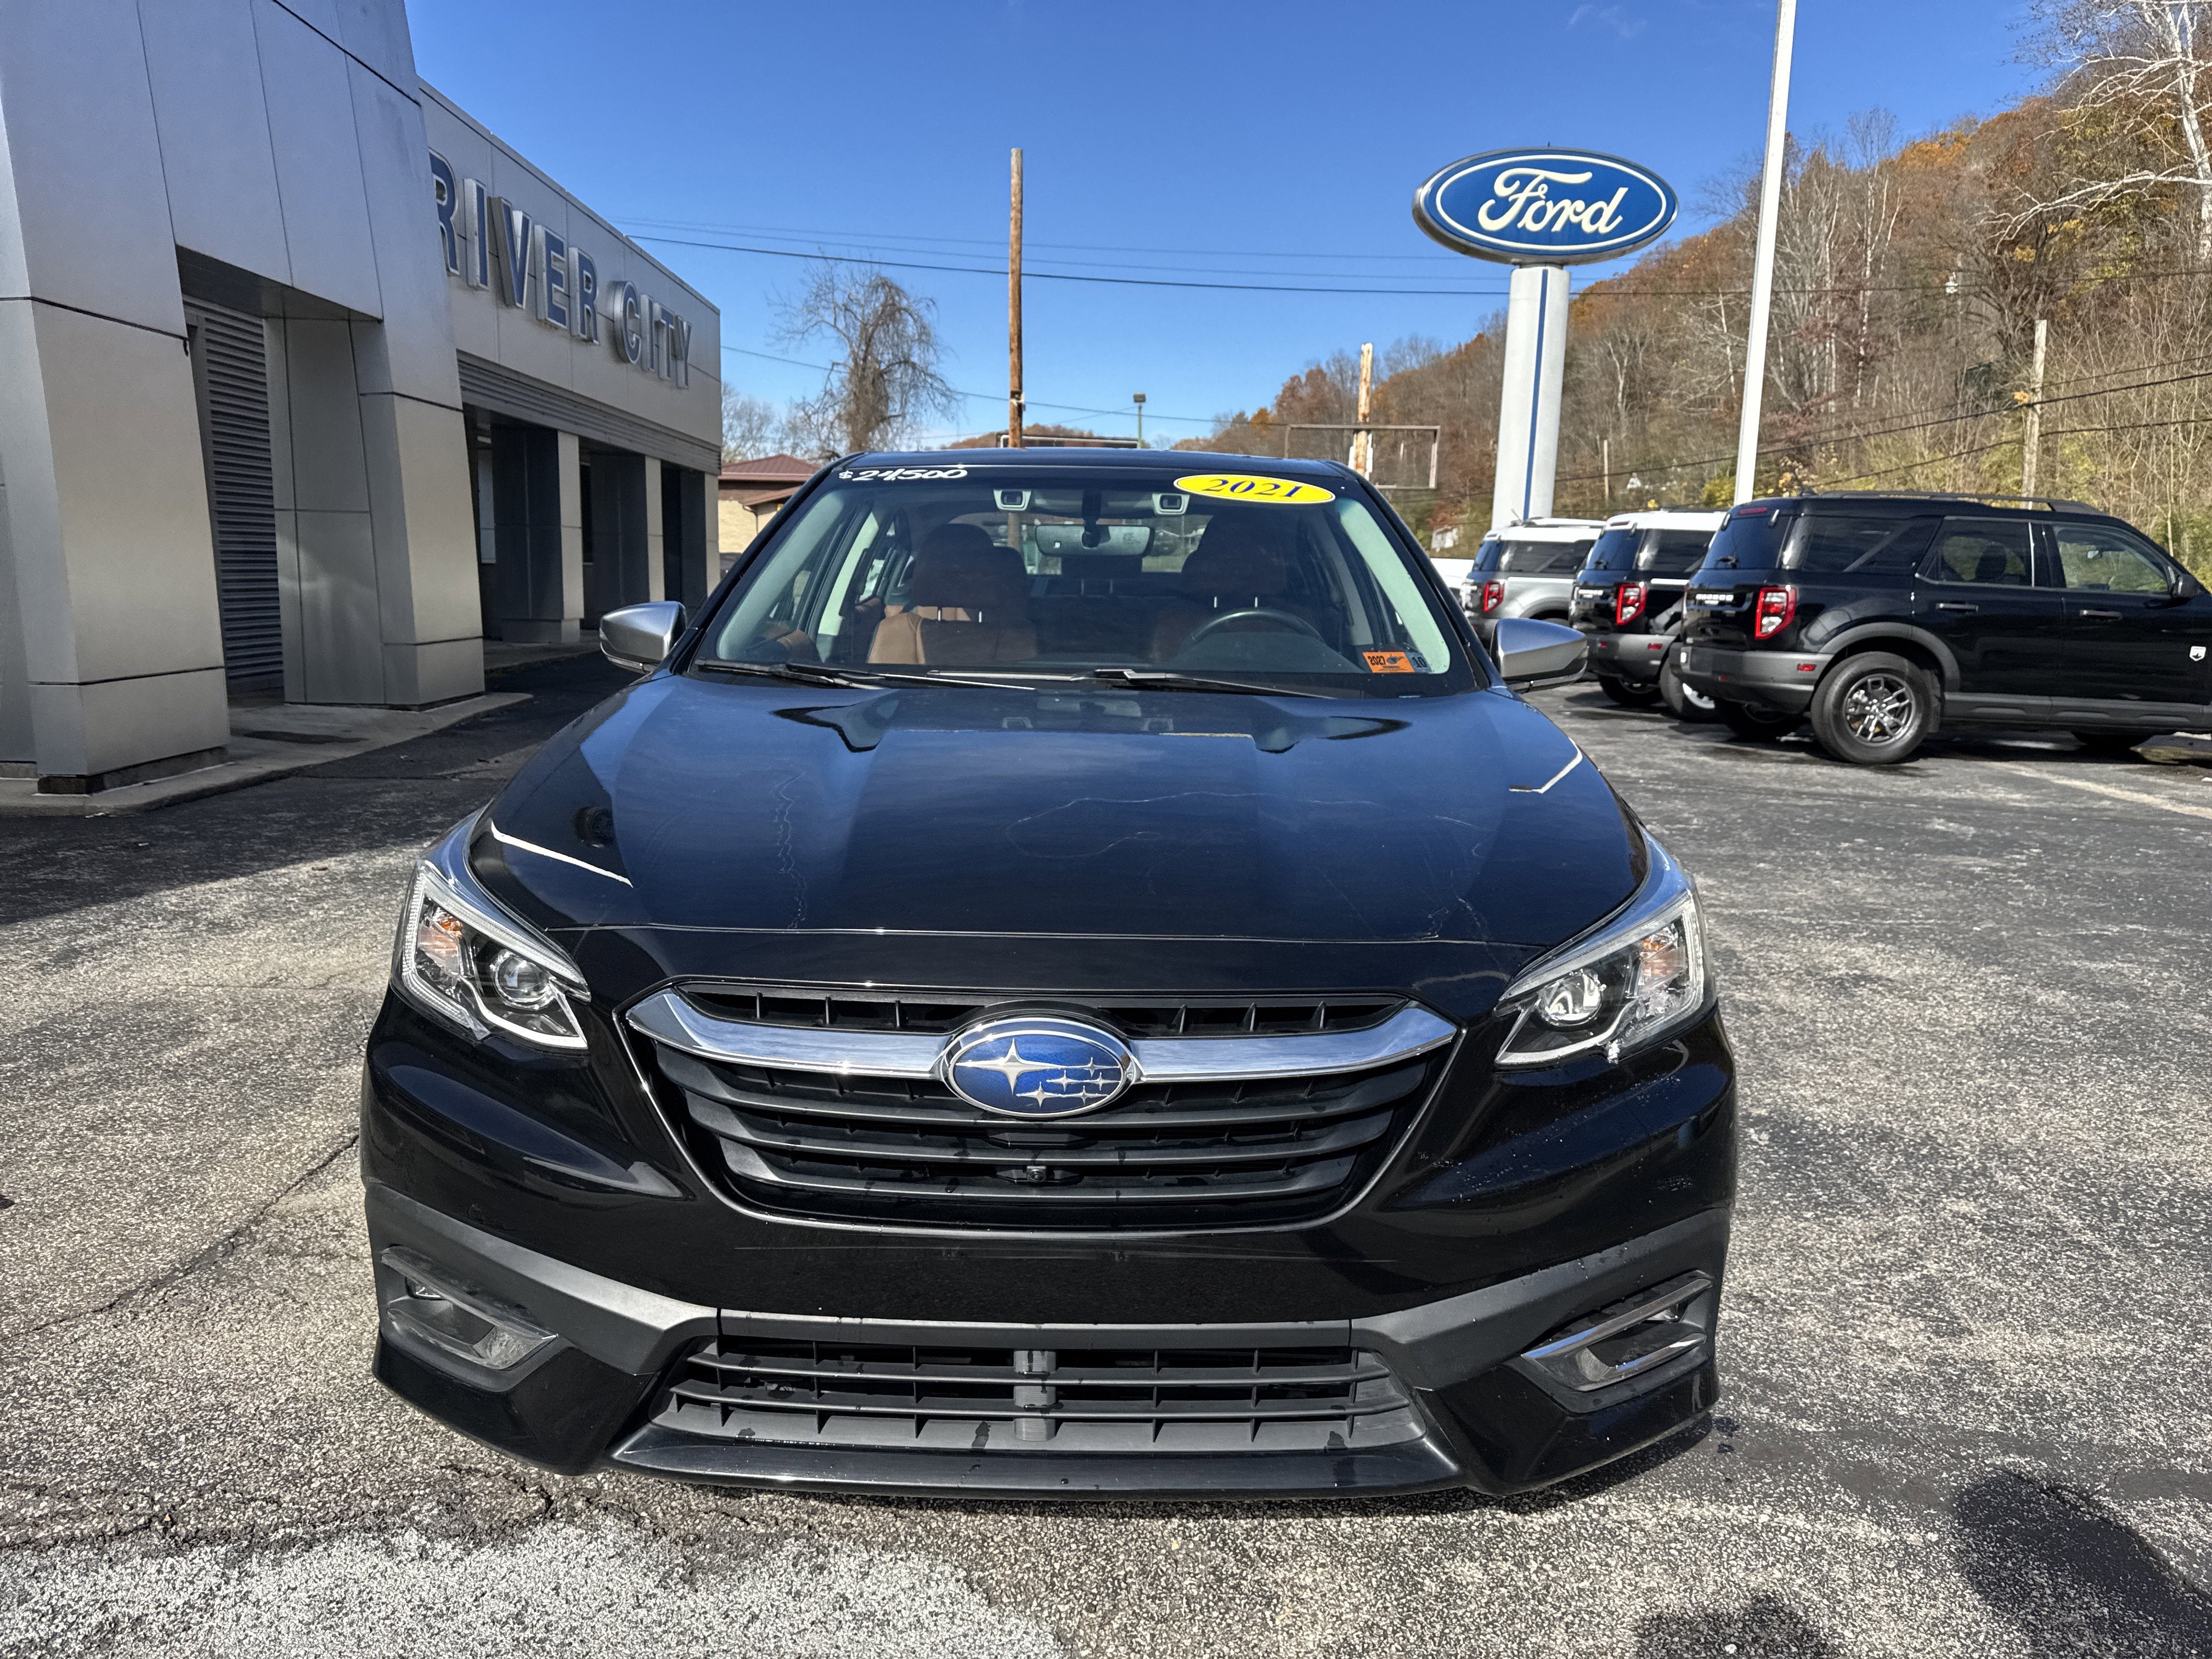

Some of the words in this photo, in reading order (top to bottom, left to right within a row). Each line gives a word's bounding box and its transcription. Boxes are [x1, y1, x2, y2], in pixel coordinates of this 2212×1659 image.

[1478, 167, 1629, 234] Ford
[428, 148, 599, 345] RIVER
[614, 280, 692, 389] CITY
[1201, 479, 1303, 498] 2021
[1368, 655, 1386, 665] 2027
